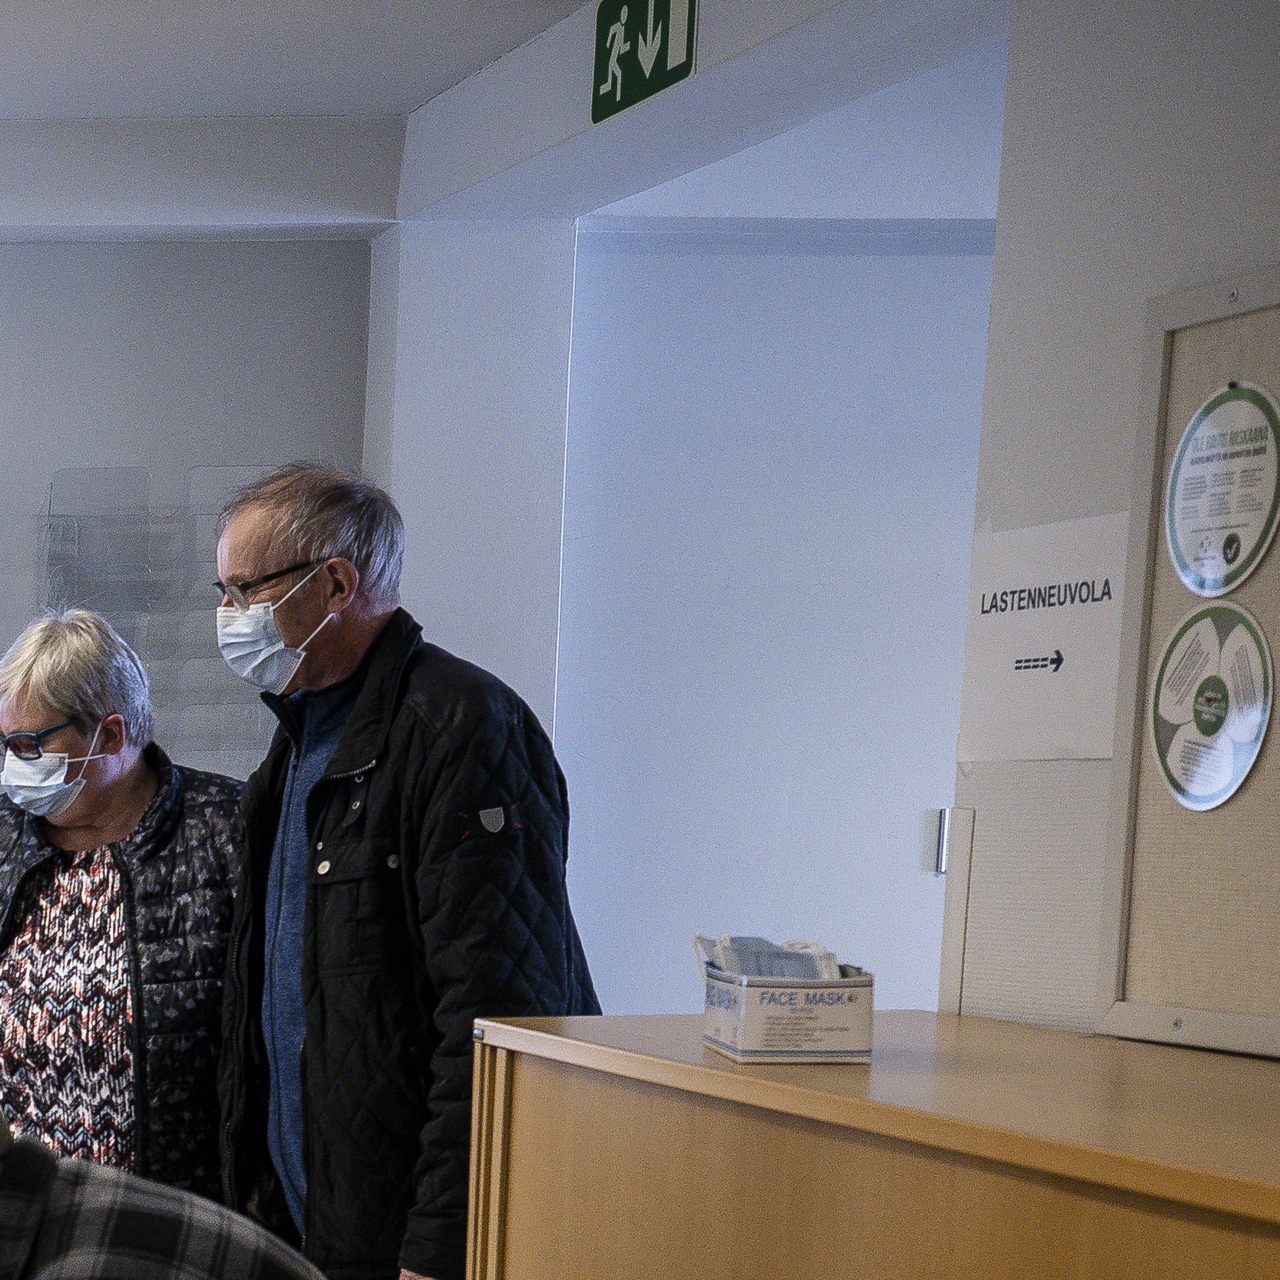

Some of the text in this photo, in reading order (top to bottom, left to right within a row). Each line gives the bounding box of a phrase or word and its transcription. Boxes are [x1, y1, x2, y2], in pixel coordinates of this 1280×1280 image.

[980, 577, 1112, 615] LASTENNEUVOLA
[759, 991, 845, 1006] FACE MASK
